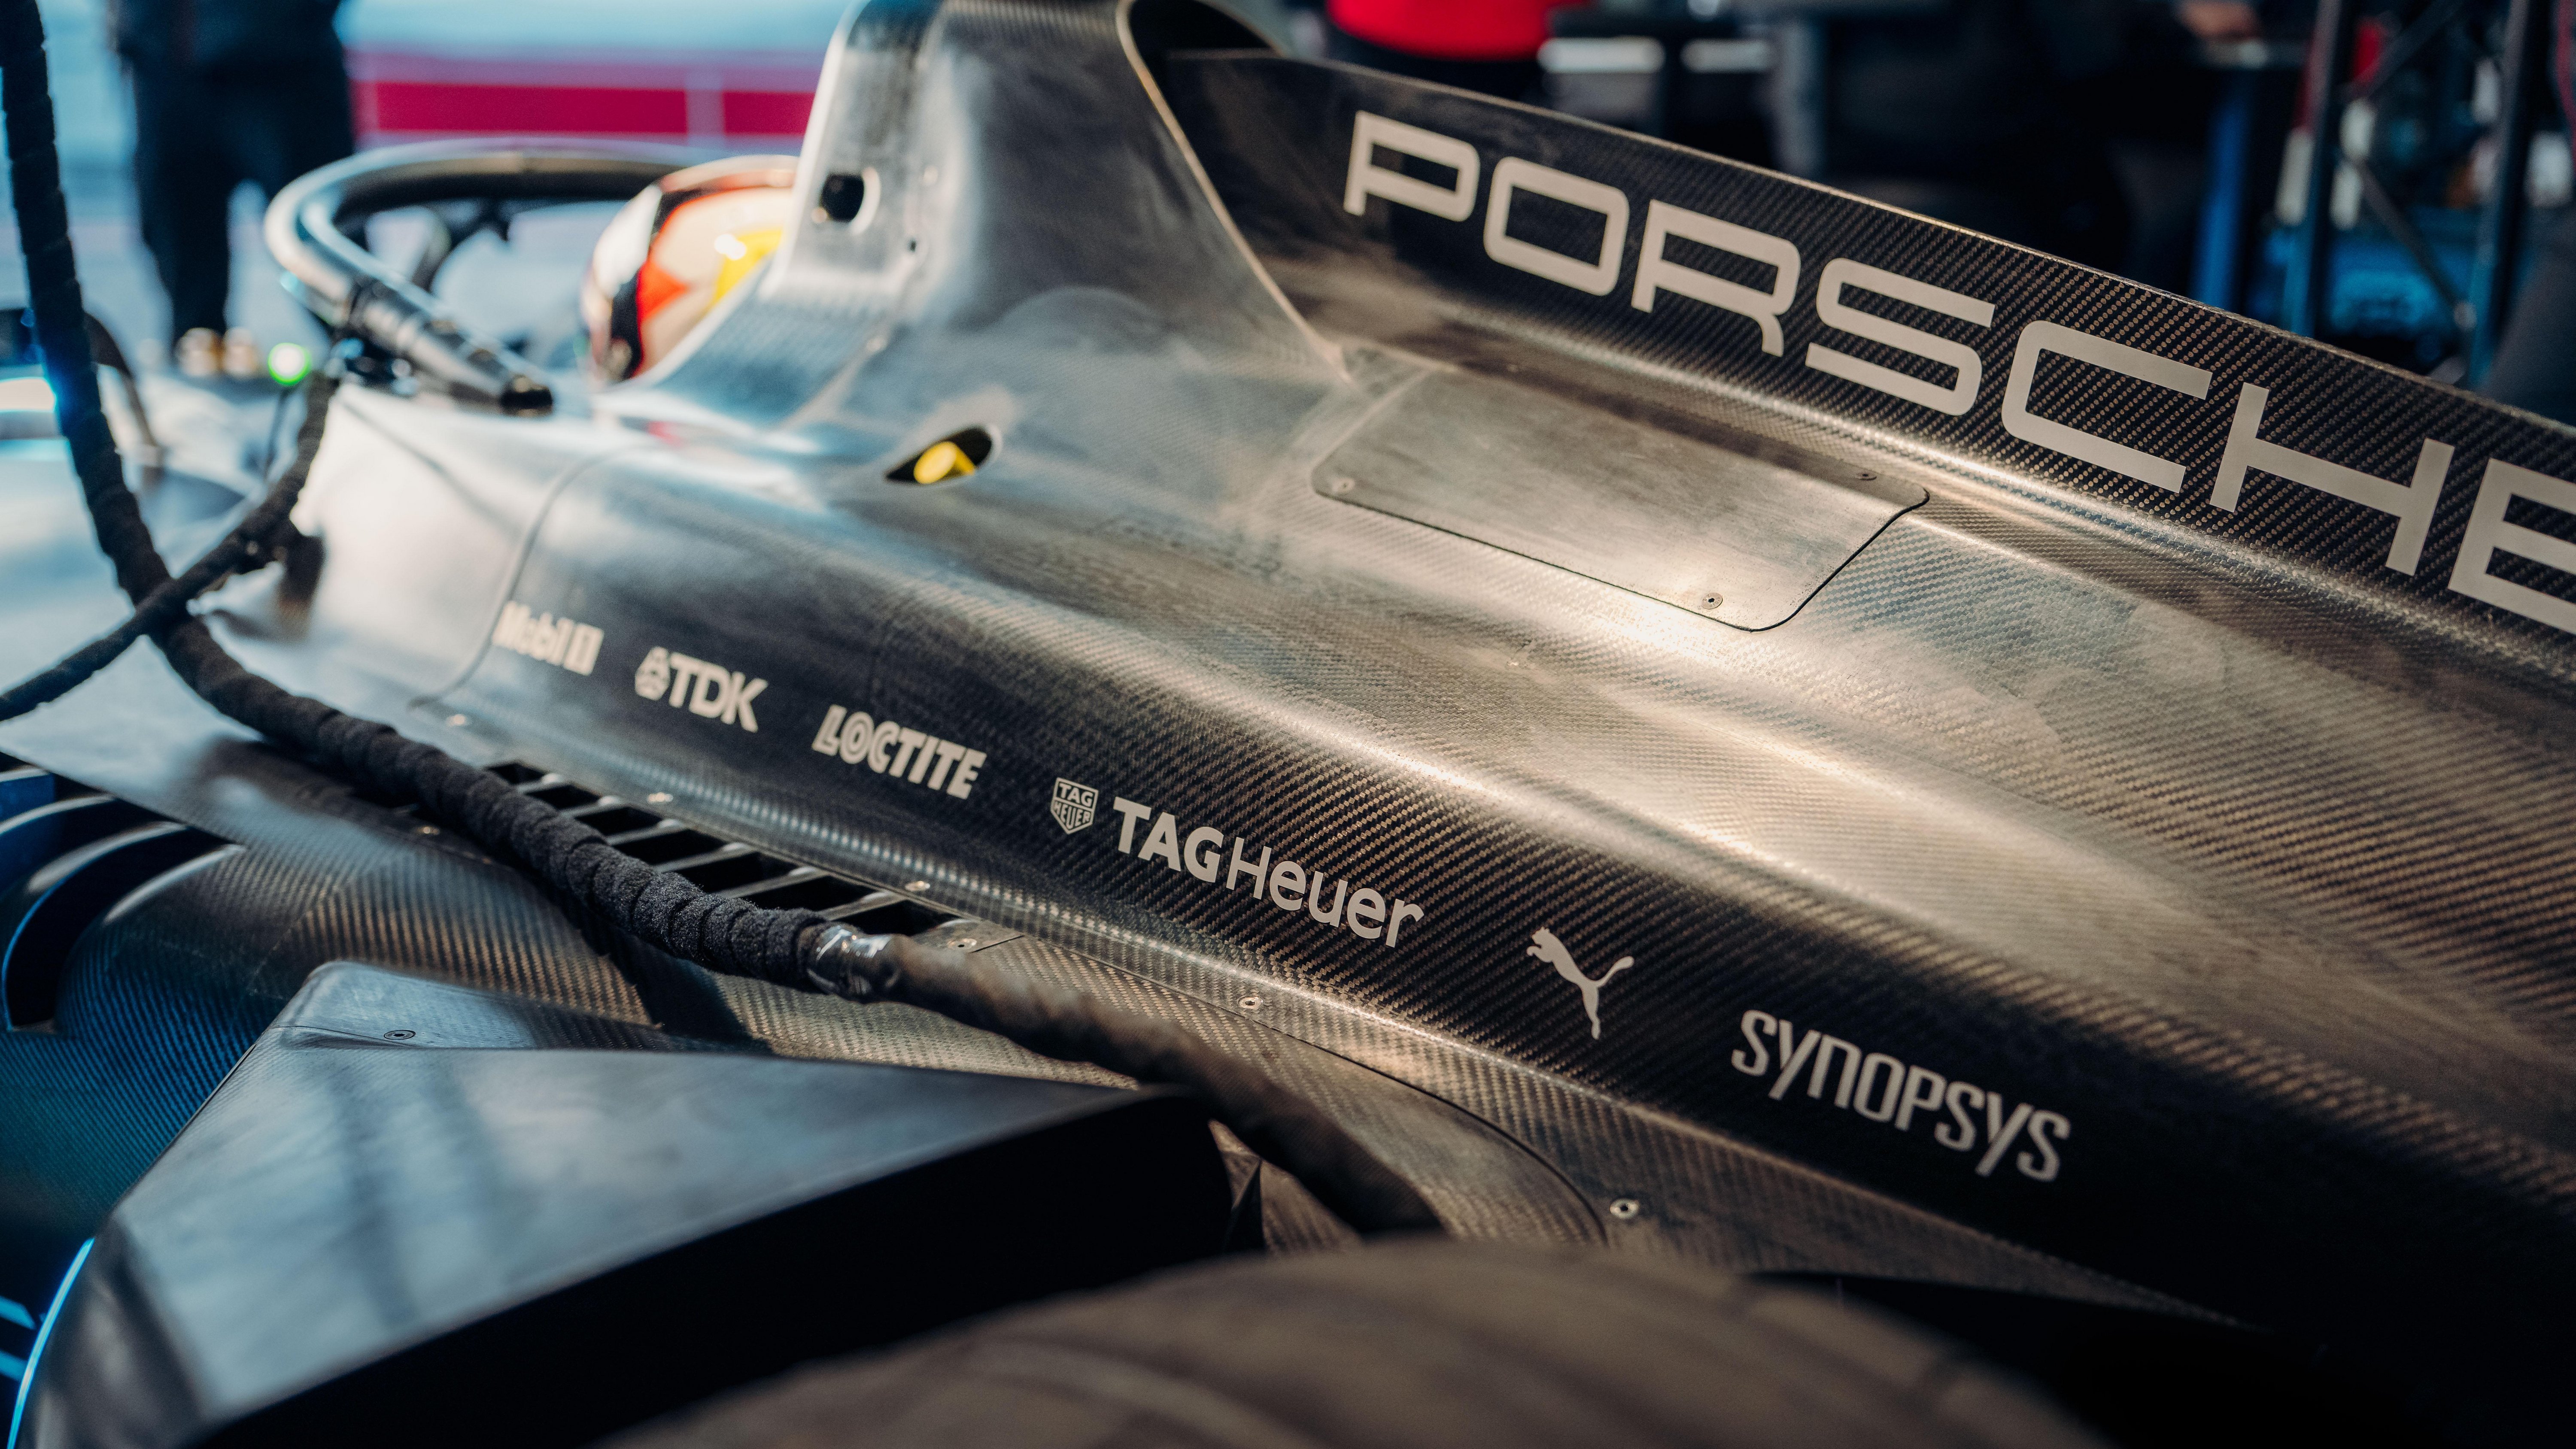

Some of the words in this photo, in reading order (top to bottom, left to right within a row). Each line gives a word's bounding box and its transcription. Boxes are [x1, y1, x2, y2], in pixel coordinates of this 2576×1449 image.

[1343, 111, 2576, 634] PORSCHE
[669, 652, 768, 733] TDK
[811, 705, 987, 799] LOCTITE
[1054, 801, 1091, 829] HEUER
[1059, 783, 1093, 807] TAG
